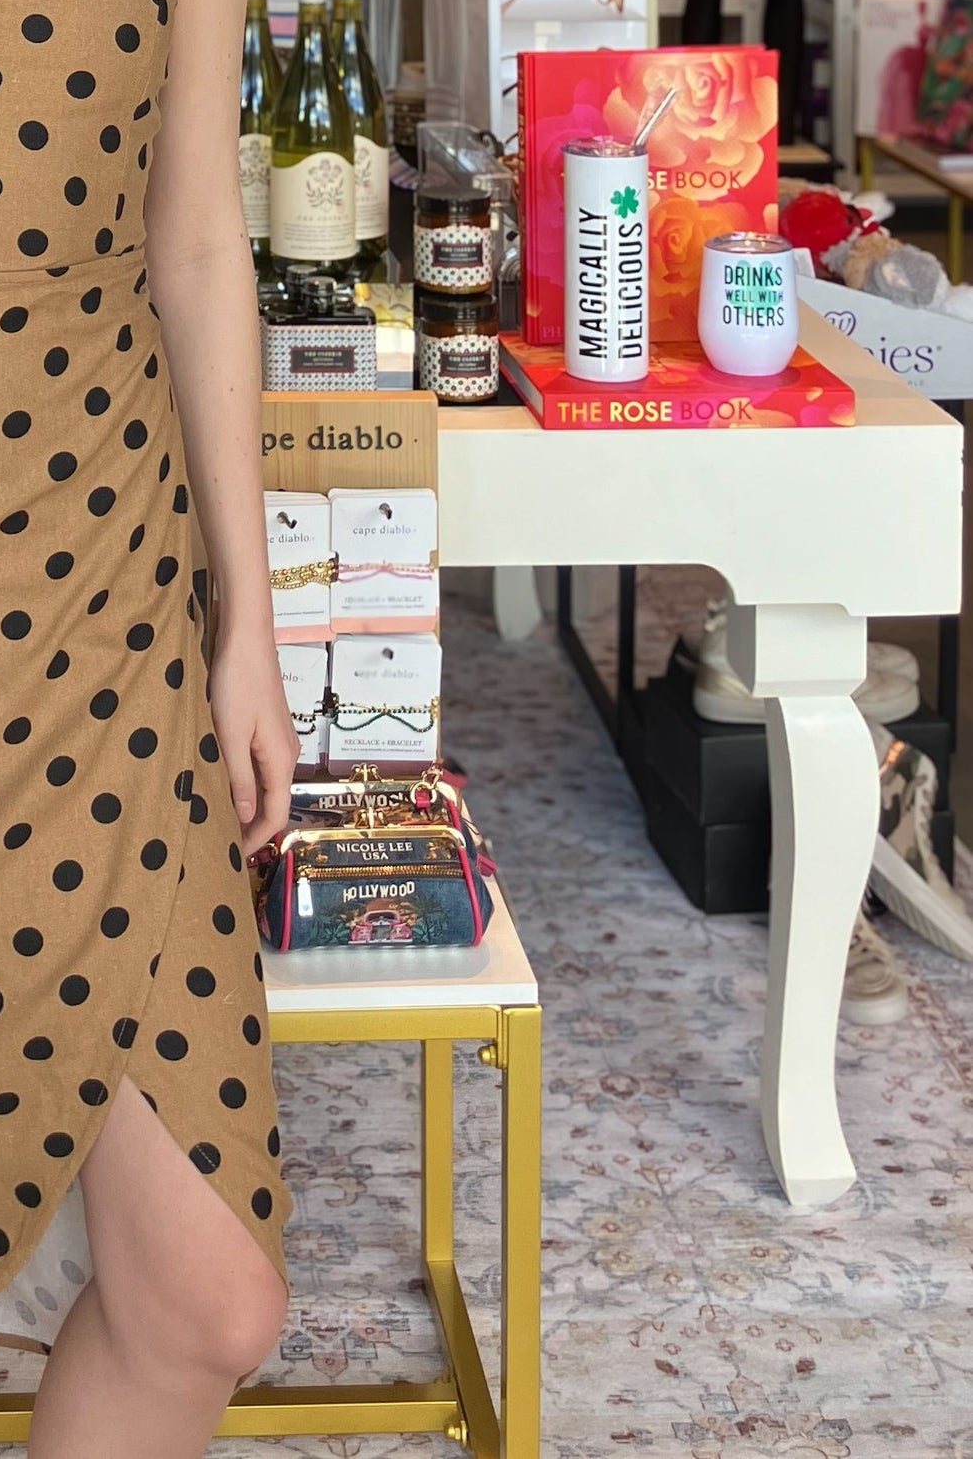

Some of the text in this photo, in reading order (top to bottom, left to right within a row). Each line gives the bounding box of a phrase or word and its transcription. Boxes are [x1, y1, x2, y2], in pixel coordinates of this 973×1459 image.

[648, 170, 743, 190] SE BOOK
[579, 207, 607, 359] MAGICALLY
[724, 265, 783, 287] DRINKS
[618, 222, 643, 359] DELICIOUS
[725, 289, 785, 303] WELL WITH
[722, 305, 785, 327] OTHERS
[863, 336, 934, 374] ies
[557, 400, 753, 423] THE ROSE BOOK
[261, 425, 403, 456] pe diablo
[278, 533, 310, 543] diablo
[352, 524, 412, 536] cape diablo
[282, 671, 299, 682] blo
[318, 792, 402, 809] HOLLYWO
[336, 843, 413, 853] NICOLE LEE
[343, 881, 416, 903] HOLLYWOOD
